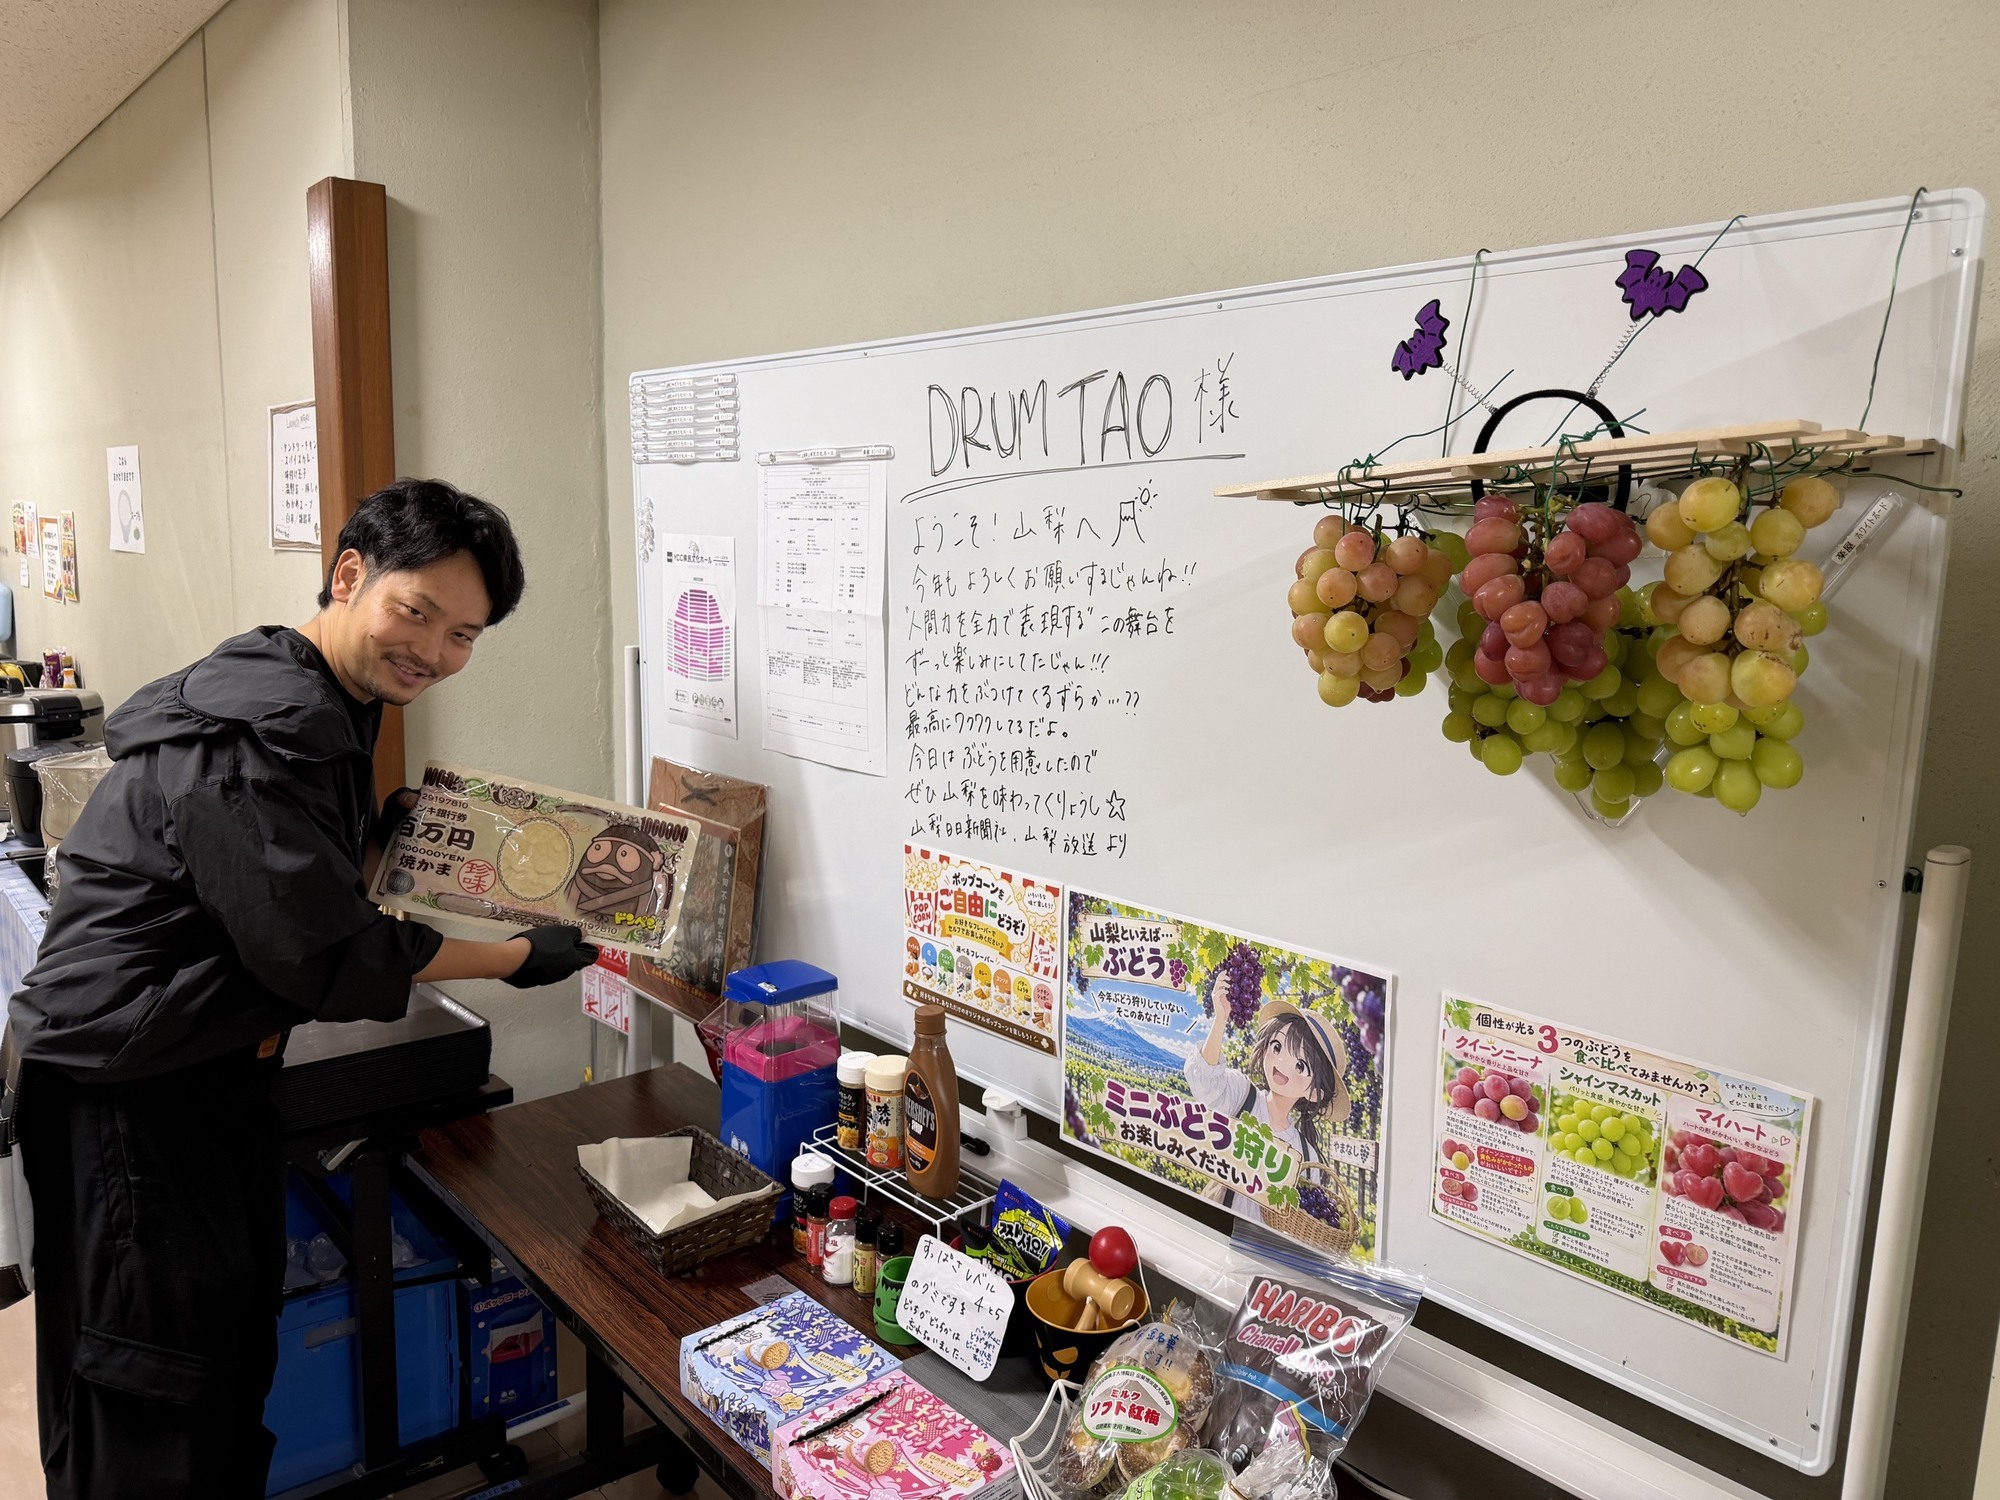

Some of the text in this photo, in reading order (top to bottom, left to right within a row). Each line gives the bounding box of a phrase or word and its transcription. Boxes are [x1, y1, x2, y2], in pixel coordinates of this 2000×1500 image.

[927, 352, 1239, 476] DRUM TAO 様
[1855, 501, 1888, 540] ホワイトボード
[908, 741, 1098, 777] 今日はぶどうを用意したので
[398, 815, 475, 851] 百万円
[398, 854, 452, 877] 焼かま
[461, 862, 494, 891] 珍味
[951, 872, 1004, 901] ポップコーンを
[913, 902, 929, 914] POP
[913, 910, 931, 923] CORN
[939, 887, 1026, 937] ご自由にどうぞ!
[954, 917, 996, 937] お好きなフレーバーで
[956, 945, 994, 964] 選べるフレーバー
[1103, 947, 1166, 979] ぶどう
[1097, 989, 1188, 1017] 今年ぶどう狩りしていない、
[1116, 1007, 1170, 1026] そこのあなた!!
[1456, 1036, 1543, 1070] クイーンニーナ
[1463, 1052, 1530, 1077] 華やかな香りと上品な甘さ
[1559, 1066, 1661, 1107] シャインマスカット
[1574, 1049, 1710, 1098] 食べ比べてみませんか?
[1725, 1083, 1757, 1092] それぞれの
[1568, 1085, 1645, 1114] パリッと食感、爽やかな甘さ
[1737, 1092, 1768, 1102] おいしさを
[875, 1103, 891, 1127] 味付
[1696, 1108, 1767, 1141] マイハート
[1105, 1080, 1293, 1183] ミニぶどう狩り
[1683, 1121, 1780, 1158] ハートの形がかわいい、希少なぶどう
[1333, 1141, 1360, 1158] やまなし
[1444, 1170, 1460, 1180] 食べ方
[1551, 1161, 1615, 1189] 食べられる人気のぶどうです。
[1550, 1184, 1569, 1196] 食べ方
[1664, 1227, 1686, 1239] 食べ方
[1666, 1197, 1777, 1242] 「マイハート」は、ハートの形をした見た目が
[923, 1239, 996, 1293] すっぱさレベル
[1002, 1261, 1024, 1279] MASTER
[974, 1296, 1004, 1320] 4と5
[1250, 1279, 1367, 1358] HARIBO
[767, 1316, 834, 1351] ビスケット
[786, 1308, 860, 1343] パチパチ
[1144, 1350, 1173, 1371] です!!
[1111, 1388, 1141, 1401] ミルク
[1309, 1377, 1335, 1400] Kiss
[885, 1395, 969, 1439] パチパチ
[1090, 1400, 1161, 1427] ソフト紅梅
[866, 1407, 945, 1452] ビスケット
